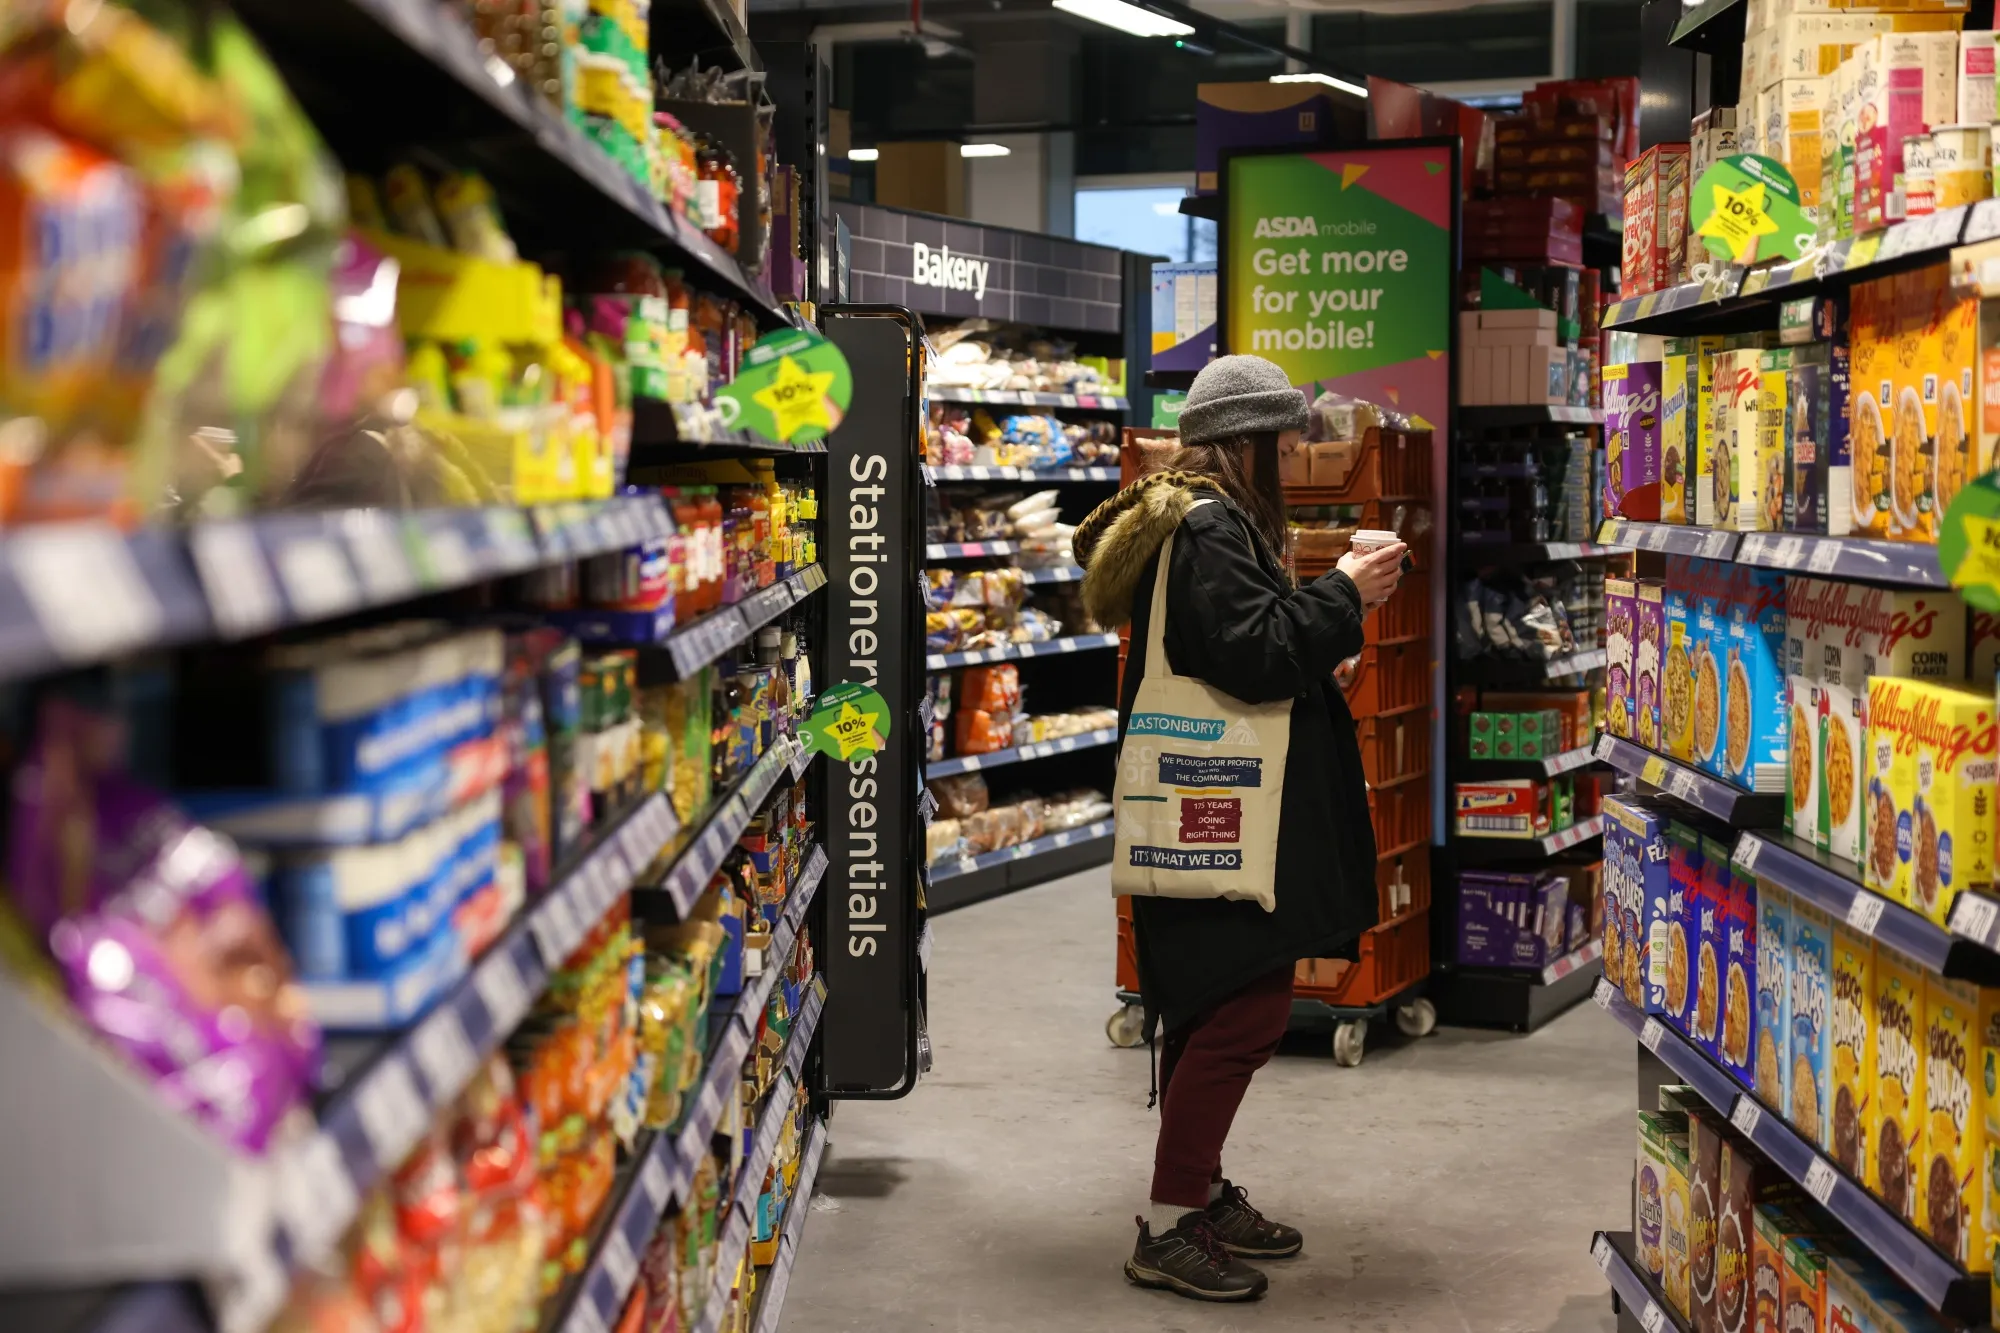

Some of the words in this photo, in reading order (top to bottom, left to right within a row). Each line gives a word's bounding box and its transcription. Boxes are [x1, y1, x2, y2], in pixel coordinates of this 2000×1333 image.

[1724, 196, 1760, 226] 10%
[1253, 216, 1318, 239] ASDA
[1321, 219, 1377, 236] mobile
[912, 242, 989, 300] Bakery
[1252, 248, 1311, 277] Get
[1321, 248, 1408, 274] more
[1252, 285, 1299, 314] for
[1307, 286, 1384, 318] your
[1252, 321, 1375, 351] mobile!
[773, 383, 815, 404] 10%
[1603, 379, 1661, 429] Kellogg's
[848, 453, 888, 688] Stationer
[1860, 586, 1939, 658] Kellogg's
[1789, 638, 1804, 659] CORN
[1824, 644, 1842, 668] CORN
[1912, 651, 1948, 665] CORN
[1824, 669, 1841, 685] FLAKES
[1912, 665, 1948, 676] FLAKES
[836, 717, 866, 735] 10%
[1870, 680, 1913, 757] Kellogg
[1913, 693, 2000, 775] Kellogg's
[1162, 756, 1175, 764] WE
[1176, 758, 1207, 767] PLOUGH
[1208, 759, 1226, 767] OUR
[1227, 759, 1257, 768] PROFITS
[1175, 773, 1190, 782] THE
[1191, 774, 1239, 782] COMMUNITY
[1194, 802, 1205, 810] 175
[1207, 801, 1233, 809] YEARS
[1198, 816, 1226, 824] DOING
[848, 742, 888, 958] ssentials
[1186, 831, 1210, 839] RIGHT
[1151, 851, 1186, 866] WHAT
[1188, 854, 1211, 866] WE
[1214, 854, 1237, 866] DO
[1646, 843, 1669, 863] FLA
[1757, 946, 1784, 1008] SNAPS
[1791, 970, 1825, 1034] SNAPS
[1834, 997, 1866, 1063] SNAPS
[1877, 1023, 1917, 1096] SNAPS
[1927, 1054, 1972, 1133] SNAPS
[1640, 1197, 1662, 1227] Cheerios
[1667, 1223, 1687, 1255] Cheerios
